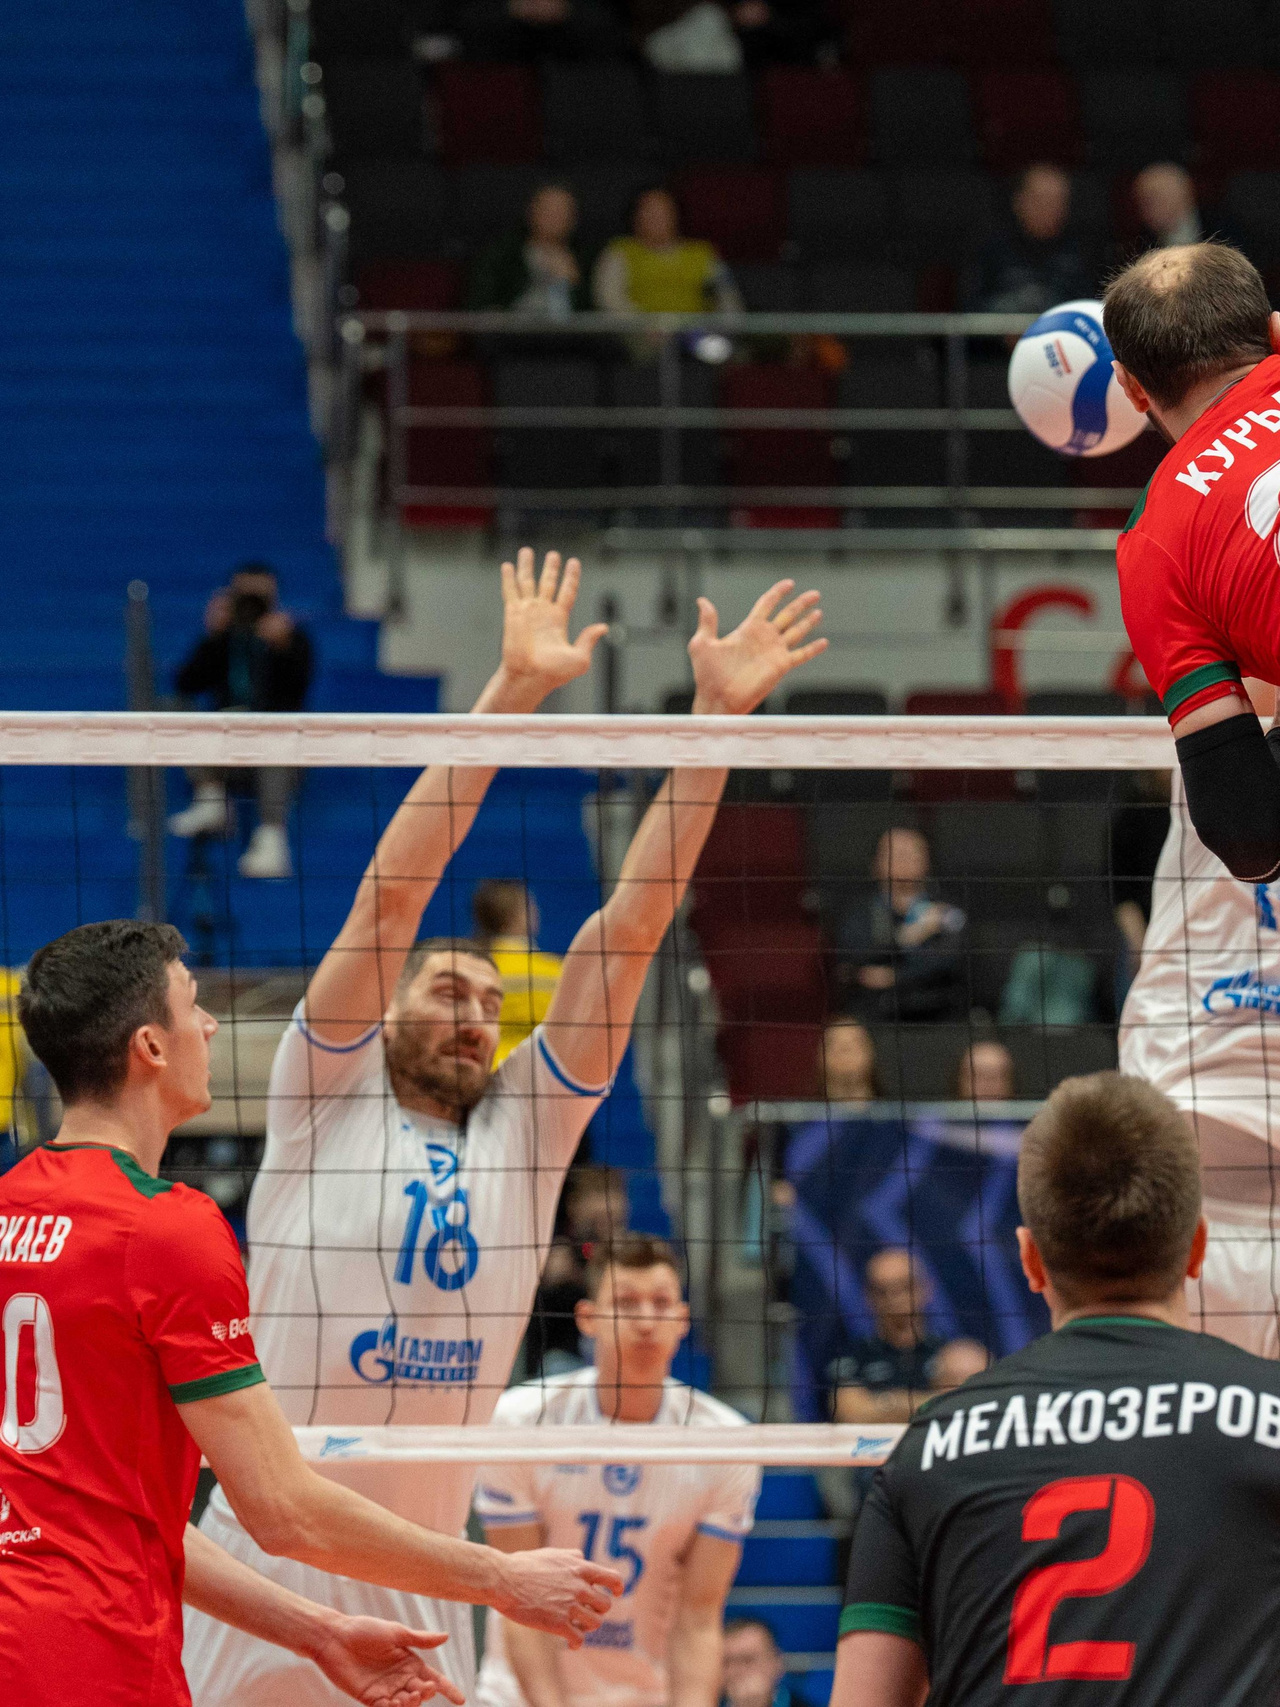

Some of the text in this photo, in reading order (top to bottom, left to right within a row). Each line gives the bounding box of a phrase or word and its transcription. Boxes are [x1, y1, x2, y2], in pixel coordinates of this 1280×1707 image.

[394, 1180, 479, 1293] 18
[577, 1511, 647, 1597] 15
[1002, 1473, 1156, 1685] 2
